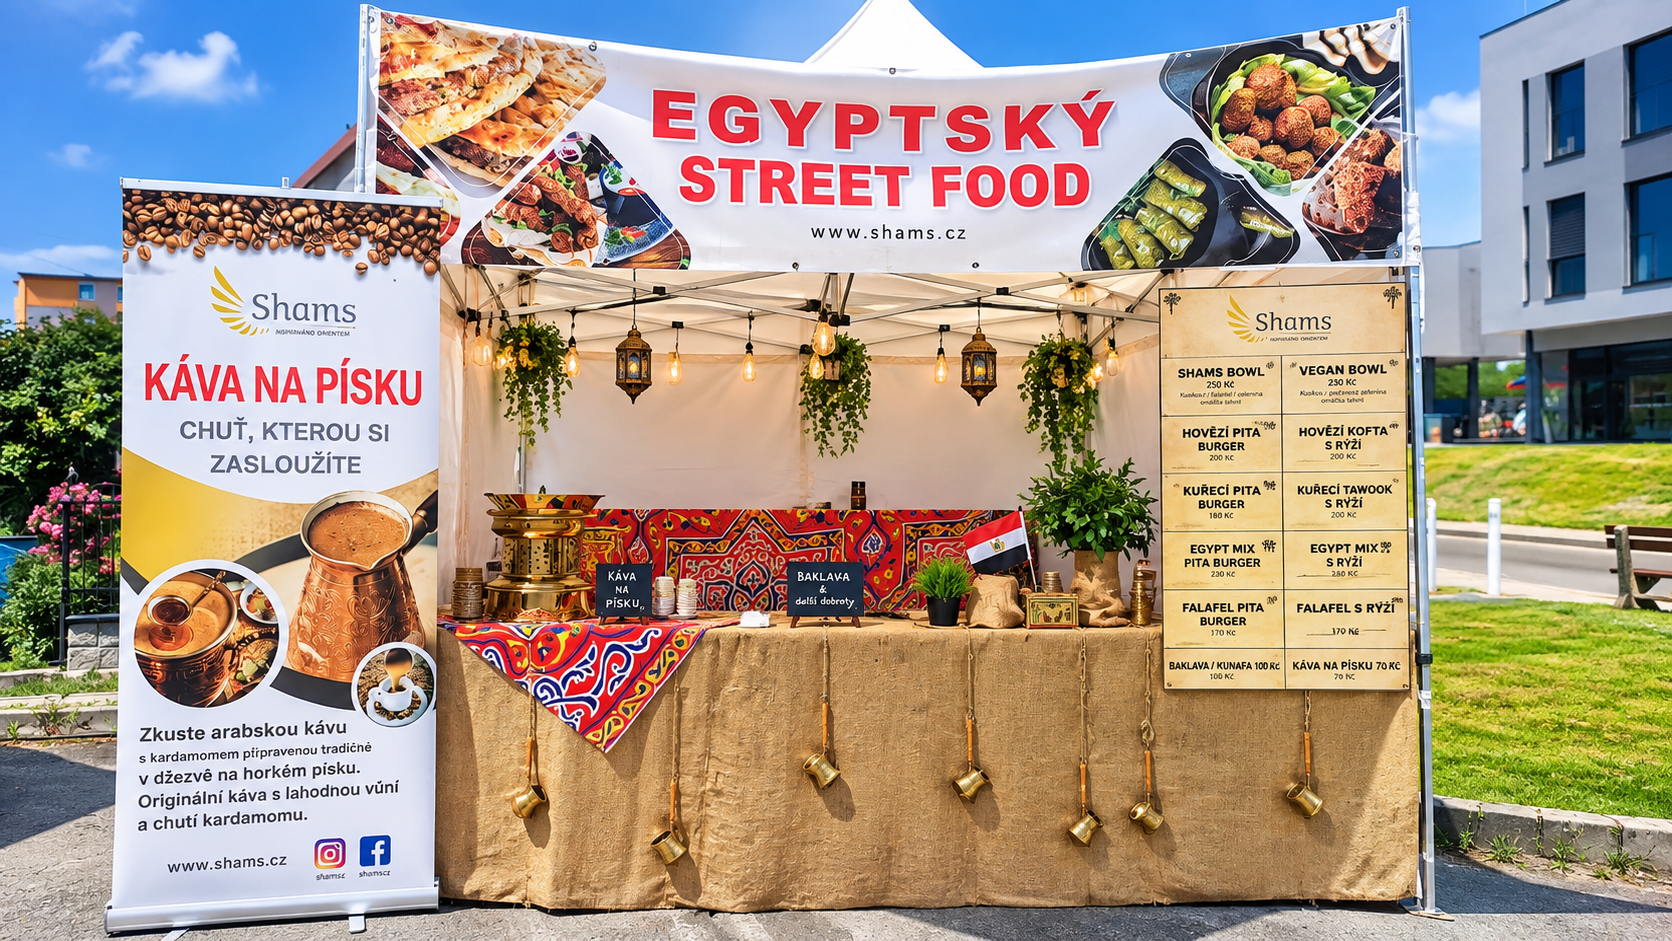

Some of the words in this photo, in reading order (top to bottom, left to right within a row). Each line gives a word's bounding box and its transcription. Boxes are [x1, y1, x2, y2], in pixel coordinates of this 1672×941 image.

[652, 89, 1115, 155] EGYPTSKÝ
[679, 155, 910, 207] STREET
[931, 162, 1090, 208] FOOD
[810, 223, 966, 240] www.shams.cz
[251, 292, 357, 324] Shams
[1255, 311, 1332, 332] Shams
[1177, 367, 1224, 379] SHAMS
[1226, 366, 1266, 378] BOWL
[1298, 364, 1345, 376] VEGAN
[1348, 363, 1388, 375] BOWL
[144, 353, 245, 402] KÁVA
[254, 365, 306, 404] NA
[316, 357, 422, 407] PÍSKU
[179, 416, 254, 444] CHUŤ,
[262, 421, 361, 442] KTEROU
[368, 423, 389, 443] SI
[1232, 427, 1261, 438] PITA
[1347, 426, 1389, 436] KOFTA
[1198, 441, 1246, 452] BURGER
[1324, 440, 1333, 451] S
[1209, 454, 1224, 462] 200
[1329, 452, 1345, 461] 200
[209, 450, 362, 475] ZASLOUŽÍTE
[1232, 485, 1262, 496] PITA
[1342, 484, 1393, 495] TAWOOK
[1198, 499, 1245, 510] BURGER
[1324, 498, 1333, 509] S
[1330, 511, 1345, 519] 200
[1190, 544, 1230, 555] EGYPT
[1232, 543, 1256, 554] MIX
[1310, 543, 1352, 554] EGYPT
[1354, 543, 1379, 554] MIX
[1184, 558, 1211, 568] PITA
[1213, 558, 1261, 568] BURGER
[1326, 557, 1334, 567] S
[607, 569, 637, 582] KÁVA
[797, 571, 851, 582] BAKLAVA
[615, 585, 629, 594] NA
[819, 584, 827, 594] &
[605, 596, 640, 609] PÍSKU
[1182, 602, 1235, 613] FALAFEL
[1237, 602, 1265, 613] PITA
[1296, 603, 1352, 614] FALAFEL
[1354, 603, 1363, 614] S
[1199, 616, 1247, 627] BURGER
[1169, 661, 1210, 670] BAKLAVA
[1210, 661, 1215, 670] /
[1216, 661, 1253, 671] KUNAFA
[1254, 661, 1269, 671] 100
[1292, 659, 1321, 671] KÁVA
[1323, 661, 1339, 671] NA
[1340, 659, 1373, 671] PÍSKU
[1376, 661, 1388, 671] 70
[139, 726, 206, 743] Zkuste
[210, 722, 298, 740] arabskou
[304, 719, 347, 736] kávu
[138, 755, 147, 764] s
[150, 750, 239, 763] kardamomem
[138, 774, 149, 786] v
[218, 770, 238, 782] na
[243, 763, 307, 781] horkém
[138, 790, 224, 811] Originální
[228, 788, 267, 804] káva
[272, 790, 281, 801] s
[285, 783, 360, 800] lahodnou
[137, 820, 148, 832] a
[153, 813, 198, 831] chutí
[202, 810, 308, 827] kardamomu.
[167, 856, 287, 874] www.shams.cz
